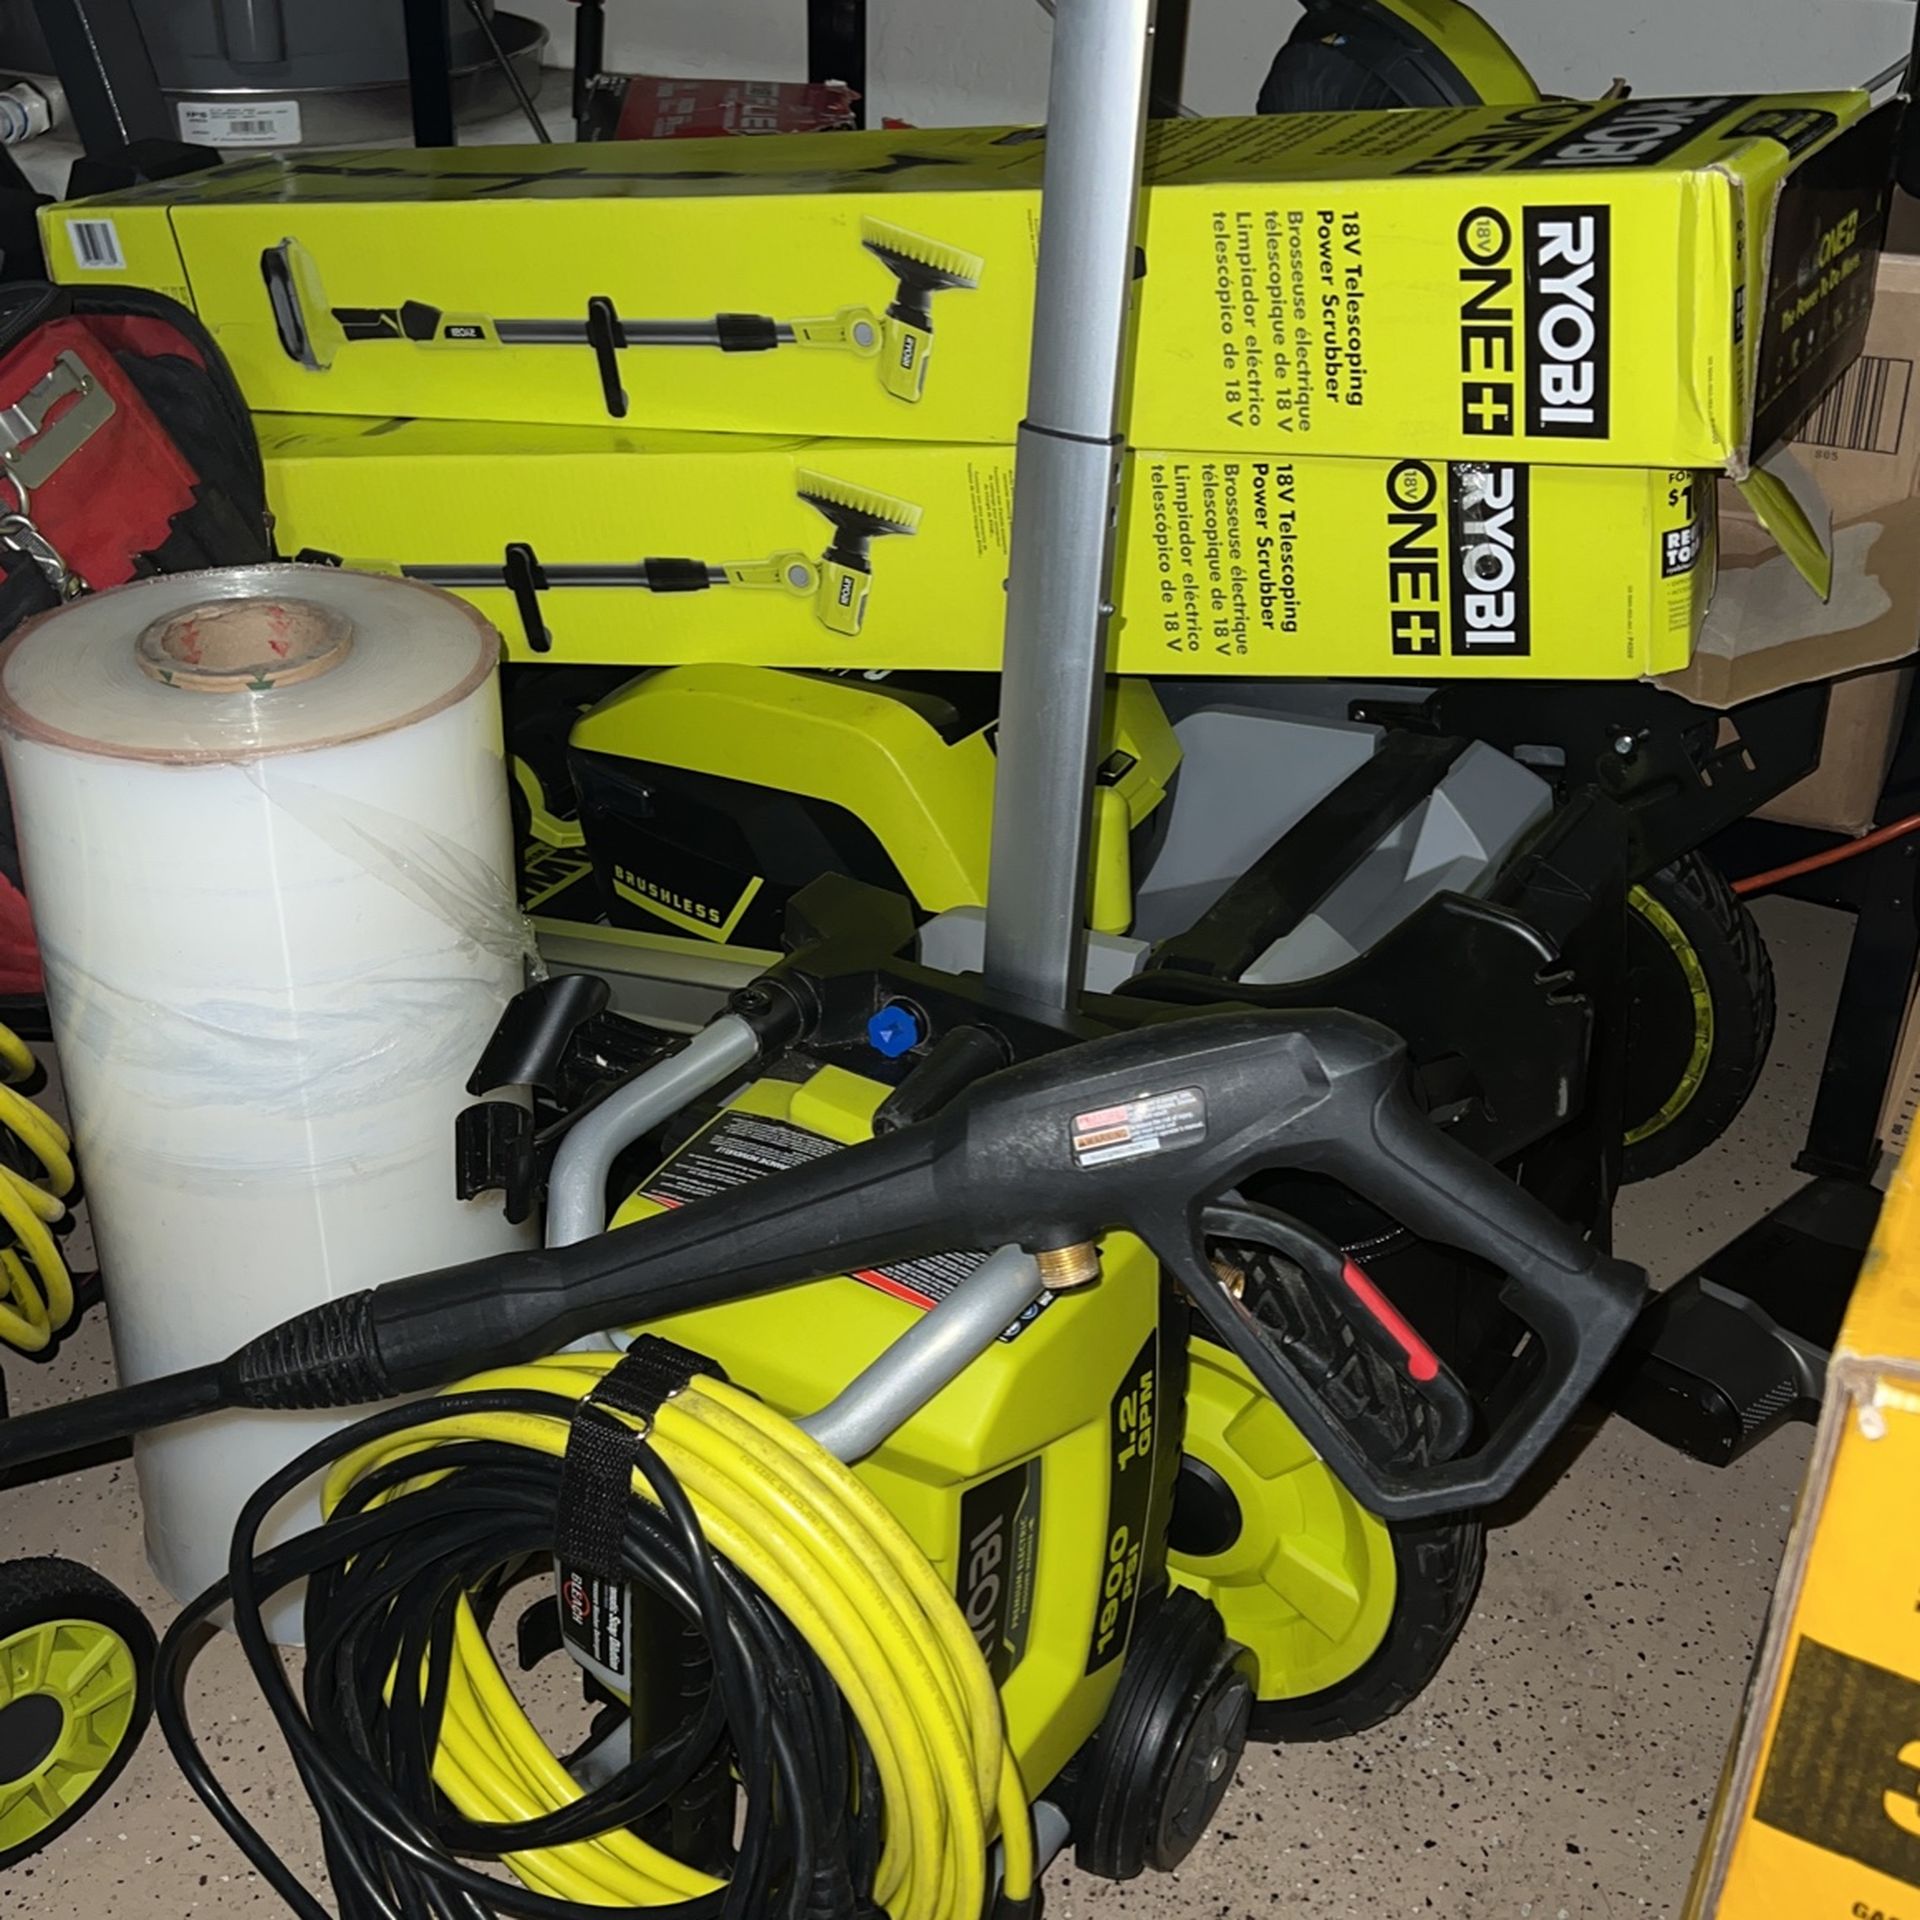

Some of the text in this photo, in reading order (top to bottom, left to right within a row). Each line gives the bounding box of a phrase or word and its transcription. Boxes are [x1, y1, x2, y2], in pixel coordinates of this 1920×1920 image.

[1540, 98, 1731, 166] RYOBI
[1212, 211, 1244, 427] telescópico de 18 V
[1235, 211, 1264, 426] Limpiador eléctrico
[1317, 210, 1344, 403] Power Scrubber
[1342, 211, 1367, 406] 18V Telescoping
[1475, 219, 1492, 252] 18V
[1538, 216, 1596, 424] RYOBI
[1264, 210, 1293, 433] télescopique de 18 V
[1287, 211, 1314, 432] Brosseuse électrique
[1151, 464, 1183, 652] telescópico de 18 V
[1173, 464, 1203, 652] Limpiador eléctrico
[1201, 463, 1232, 656] télescopique de 18 V
[1223, 463, 1250, 655] Brosseuse électrique
[1252, 463, 1277, 630] Power Scrubber
[1276, 464, 1301, 633] 18V Telescoping
[1404, 470, 1417, 499] 18V
[1462, 468, 1516, 643] RYOBI
[613, 864, 721, 924] BRUSHLESS
[1118, 1390, 1138, 1472] 1.2
[1137, 1370, 1153, 1457] GPM
[571, 1572, 583, 1625] BLEACH
[966, 1514, 1004, 1660] OBI
[1017, 1515, 1028, 1571] ELECTRIC
[1097, 1525, 1129, 1655] 1900
[1122, 1542, 1140, 1601] PSI
